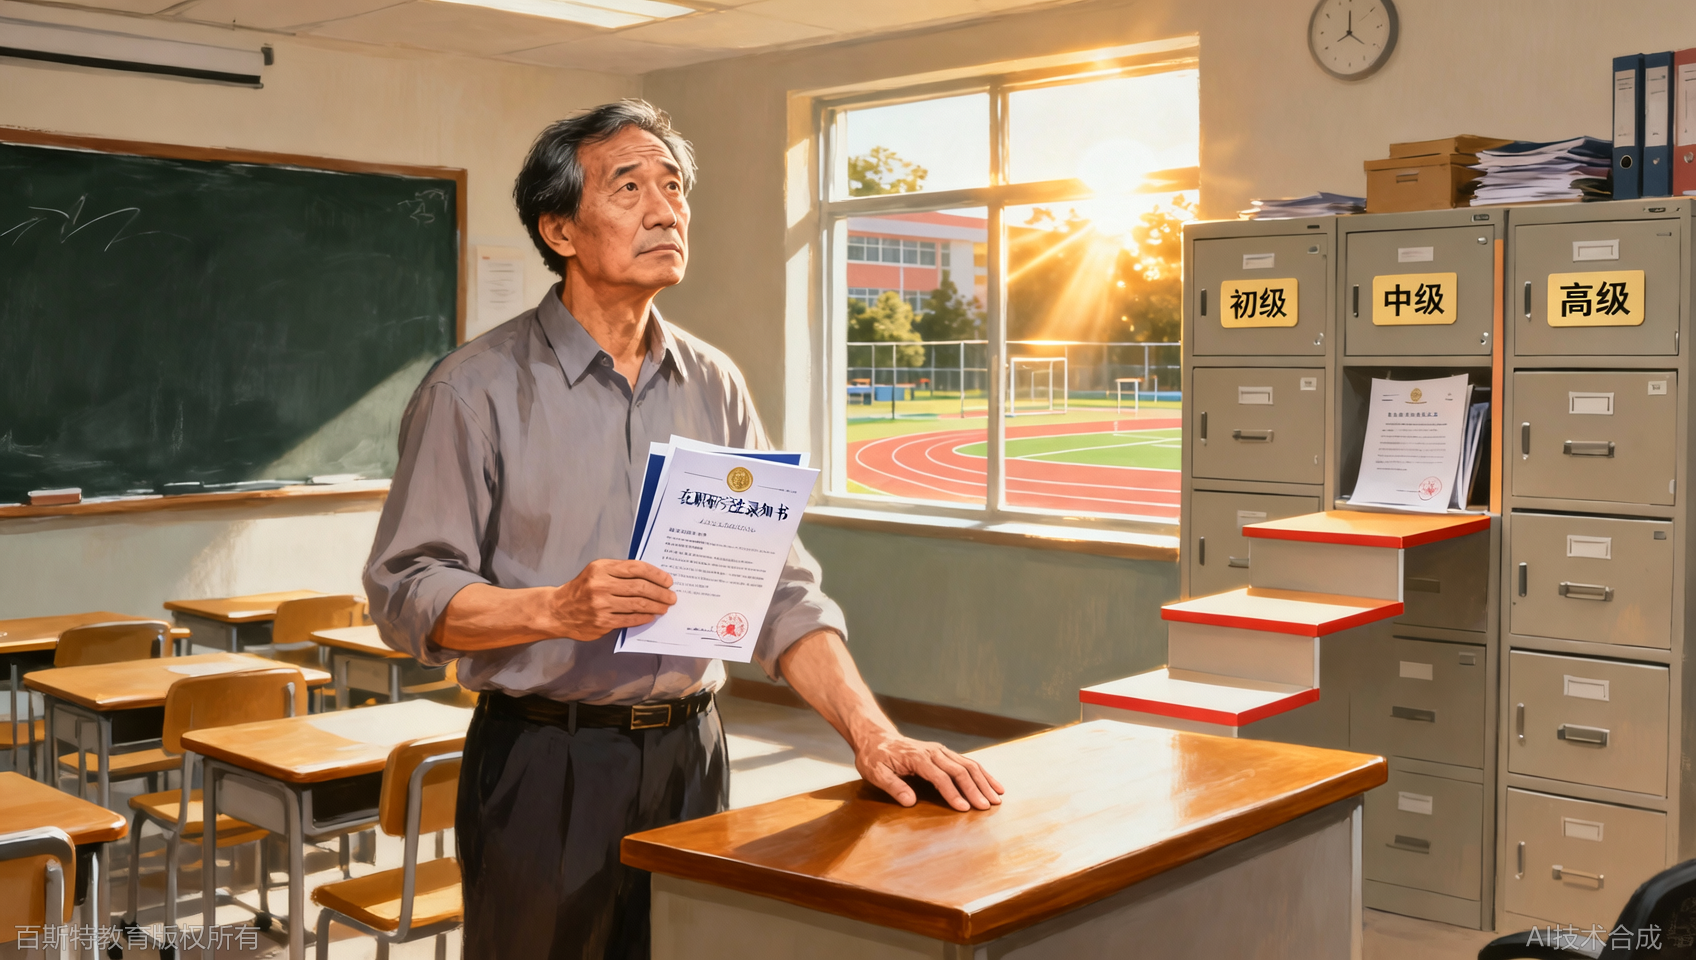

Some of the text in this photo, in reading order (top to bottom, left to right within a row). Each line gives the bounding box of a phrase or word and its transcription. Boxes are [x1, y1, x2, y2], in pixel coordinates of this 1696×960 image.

[1229, 287, 1288, 320] 初级
[1383, 283, 1446, 316] 中级
[1559, 281, 1631, 317] 高级
